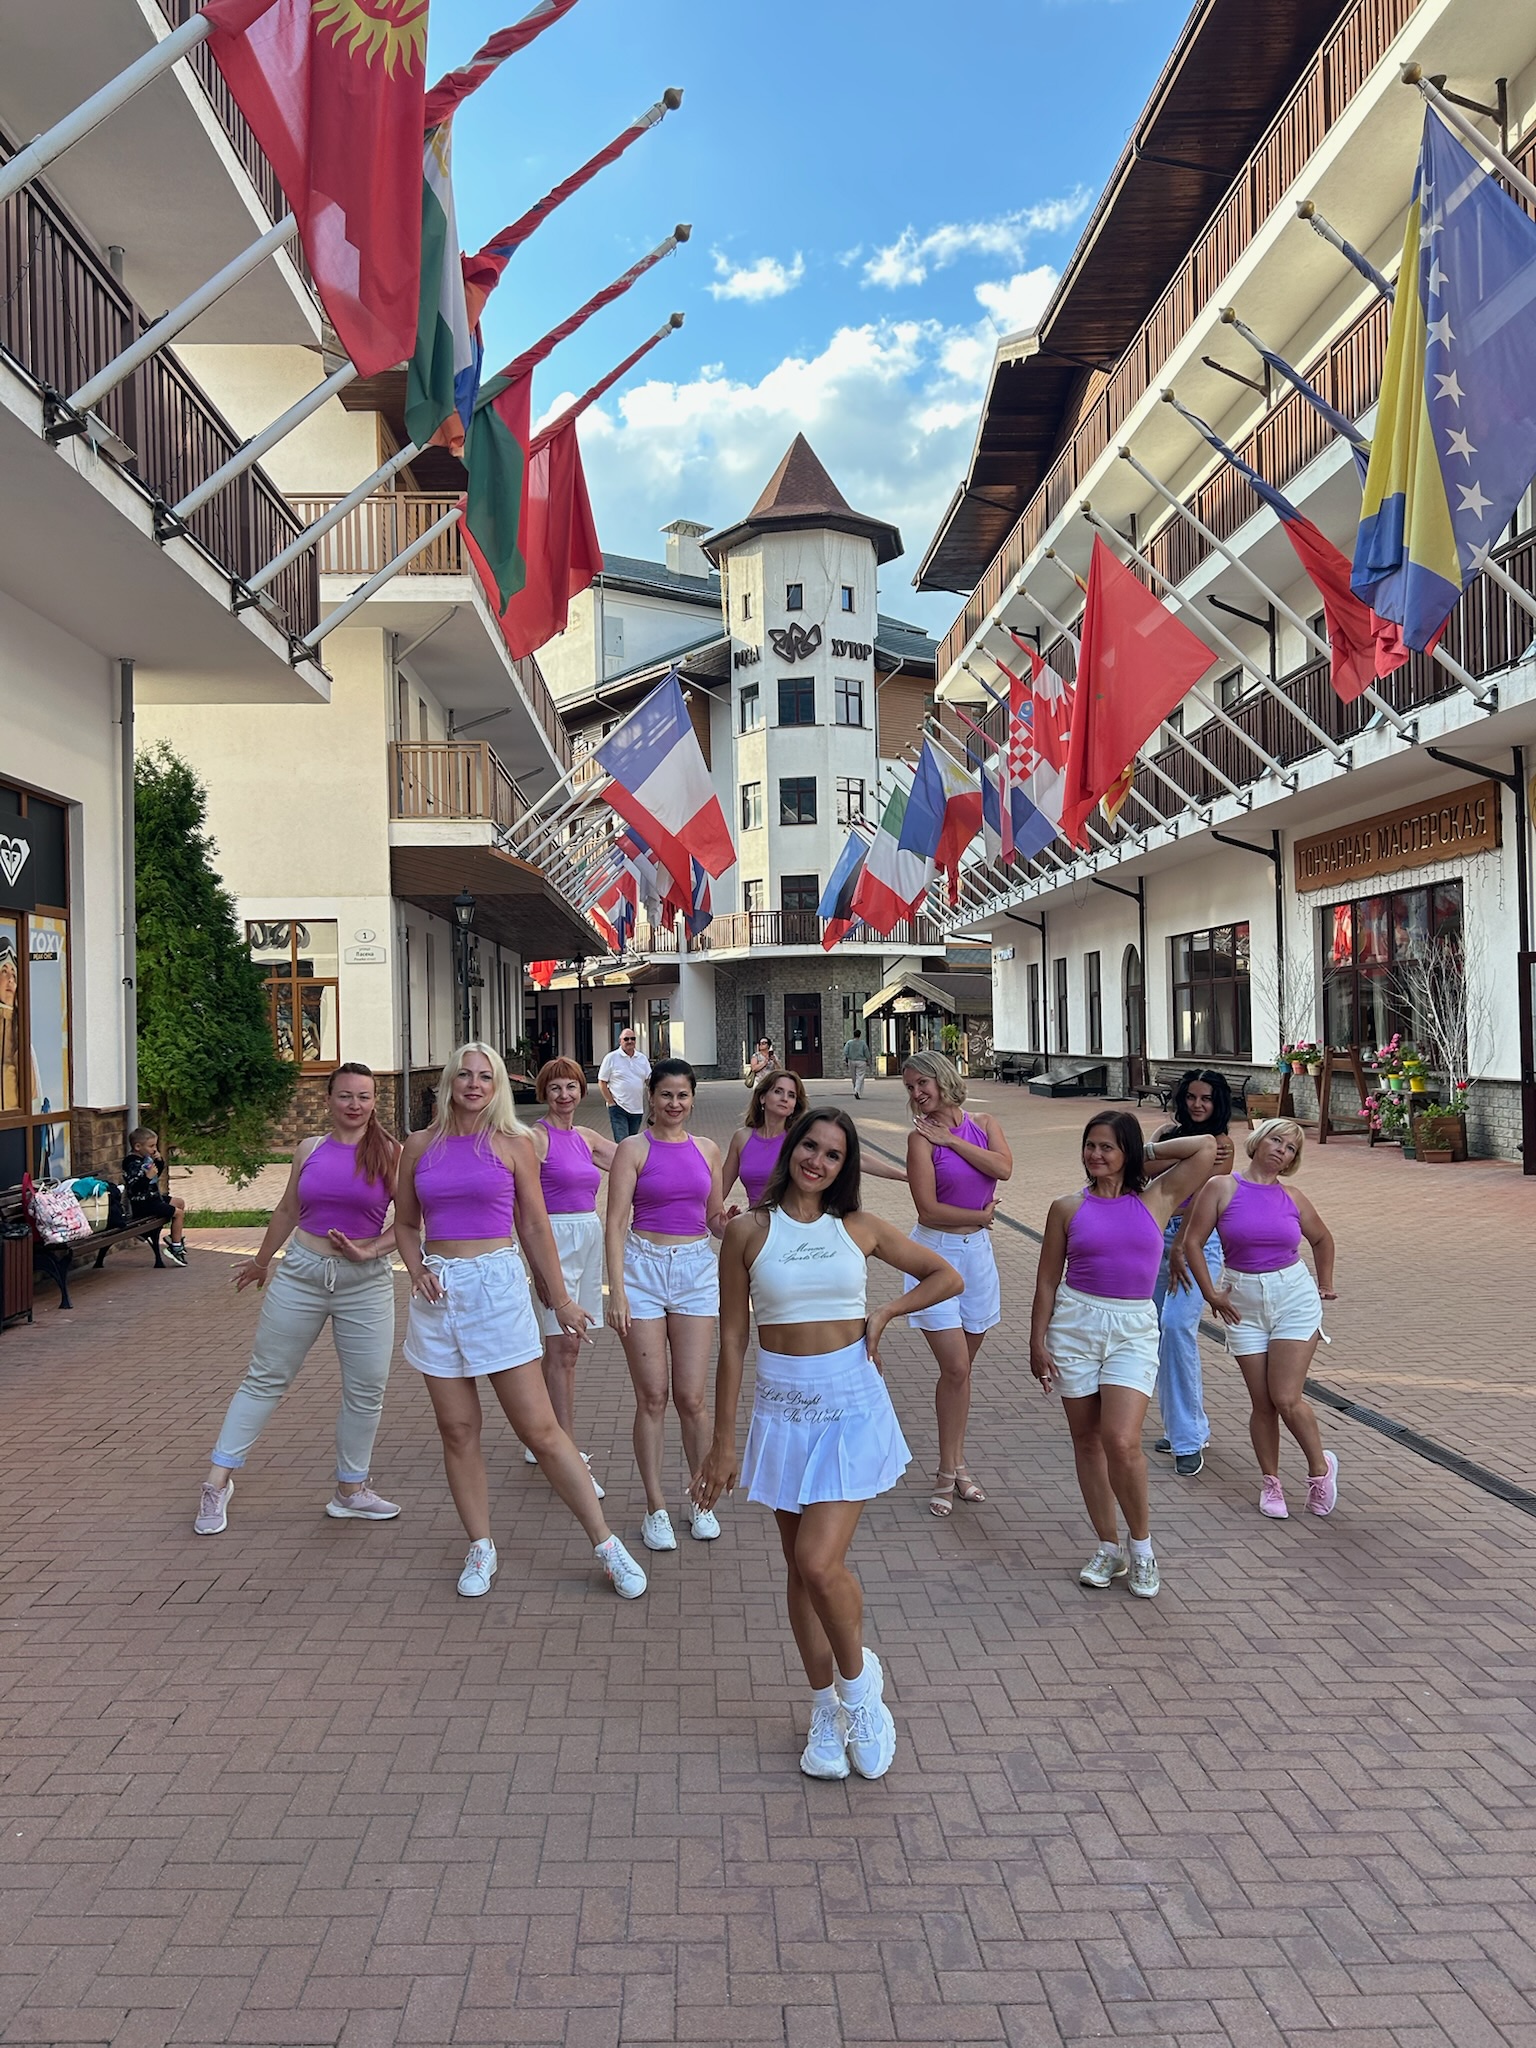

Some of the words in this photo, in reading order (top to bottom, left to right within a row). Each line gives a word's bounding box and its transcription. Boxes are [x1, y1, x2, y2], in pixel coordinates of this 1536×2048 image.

[832, 638, 873, 661] ХУТОР
[1299, 831, 1372, 880] ГОНЧАРНАЯ
[1377, 798, 1487, 860] МАСТЕРСКАЯ
[810, 1250, 837, 1259] Club
[786, 1390, 822, 1410] Bright
[805, 1408, 844, 1424] World
